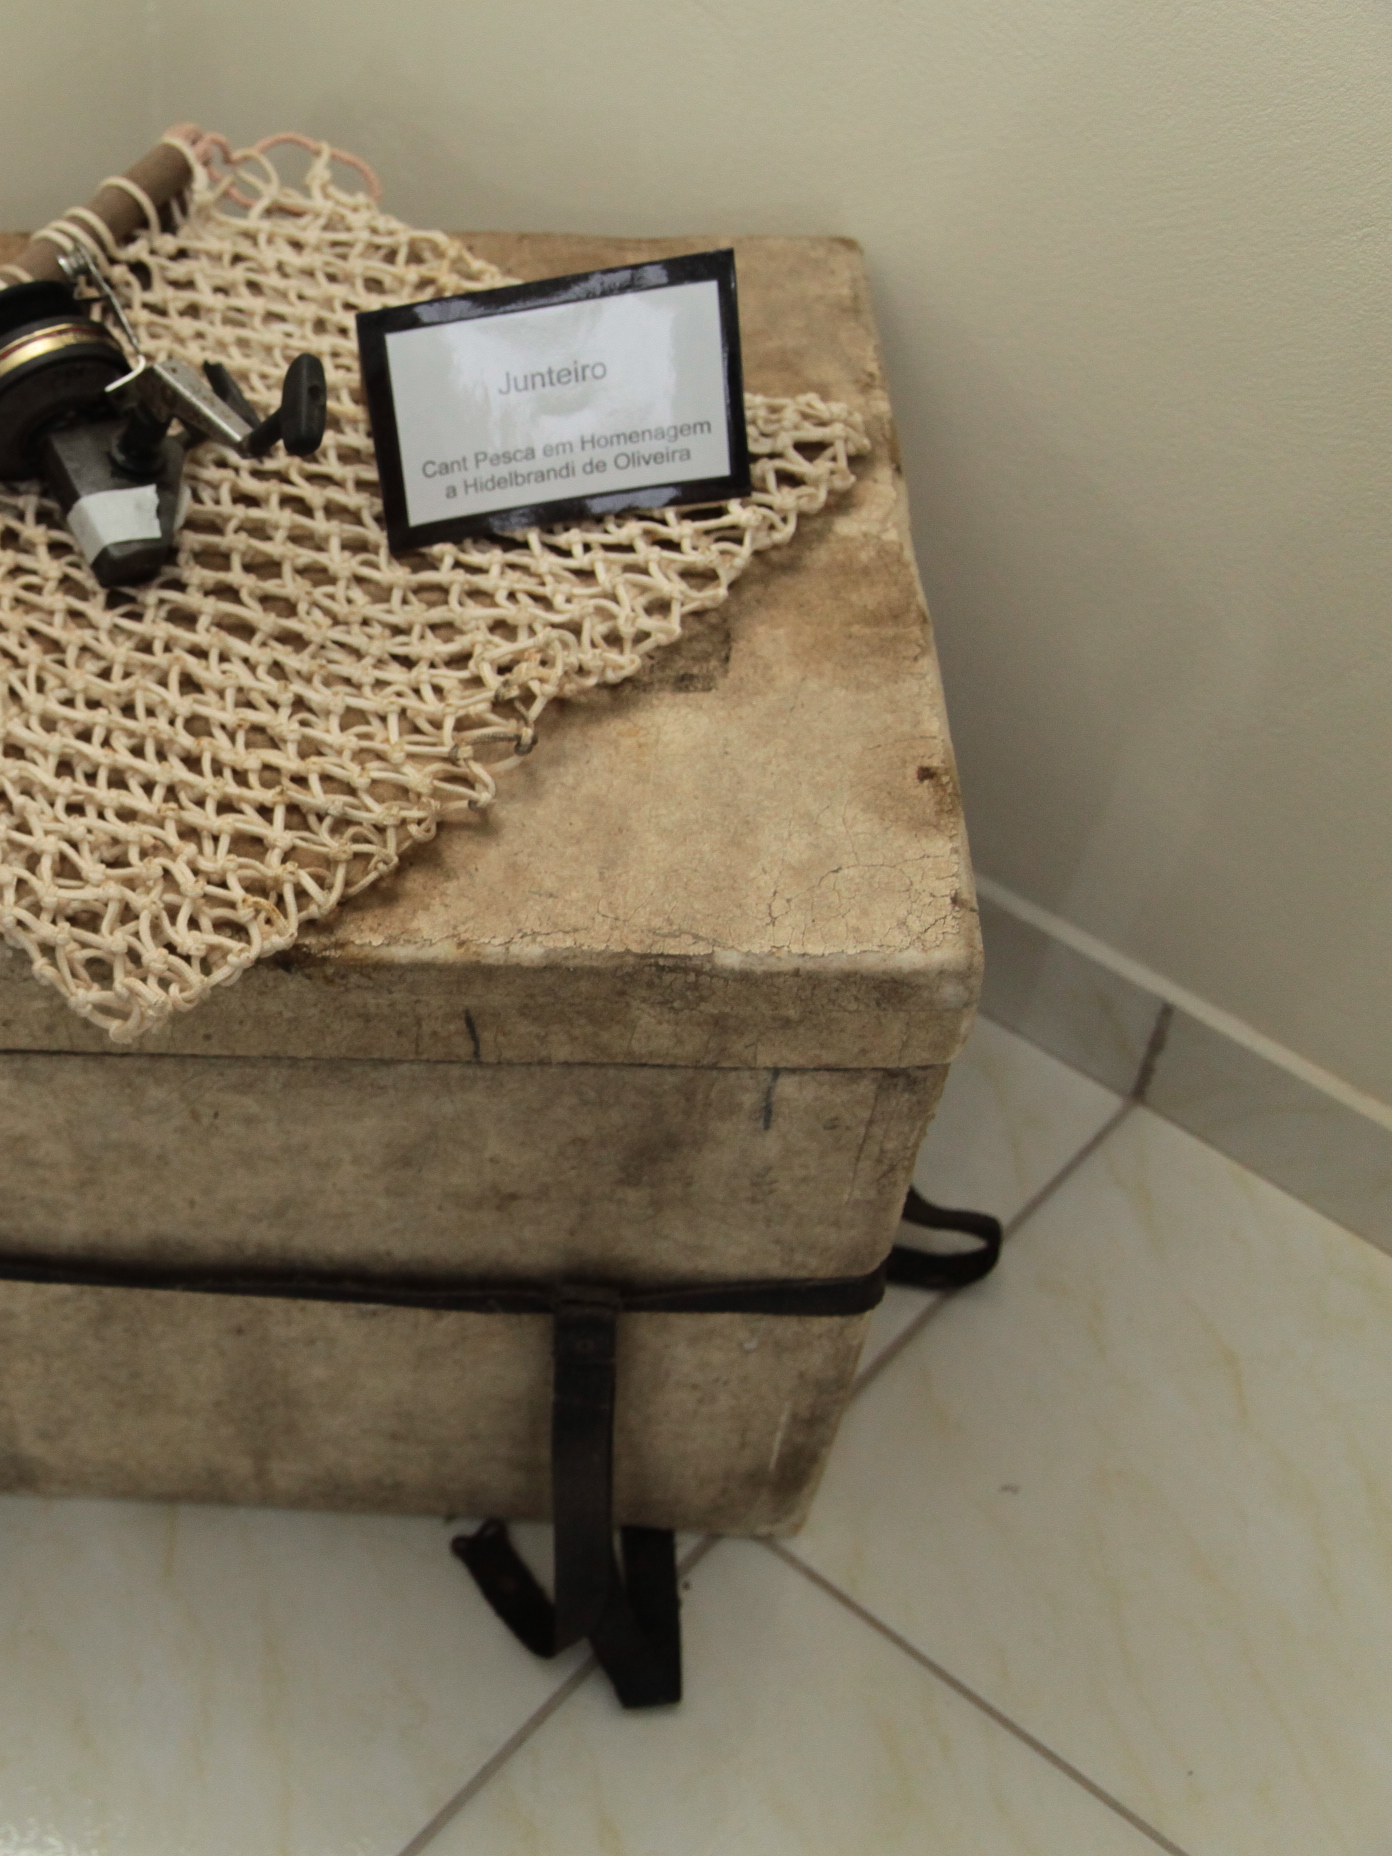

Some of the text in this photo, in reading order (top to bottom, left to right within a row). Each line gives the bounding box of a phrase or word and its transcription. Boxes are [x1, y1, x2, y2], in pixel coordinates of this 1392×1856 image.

[498, 360, 607, 395] Junteiro
[421, 420, 712, 479] Cant Pesca em Homenagem
[445, 448, 691, 499] a Hidelbrandi de Oliveira
